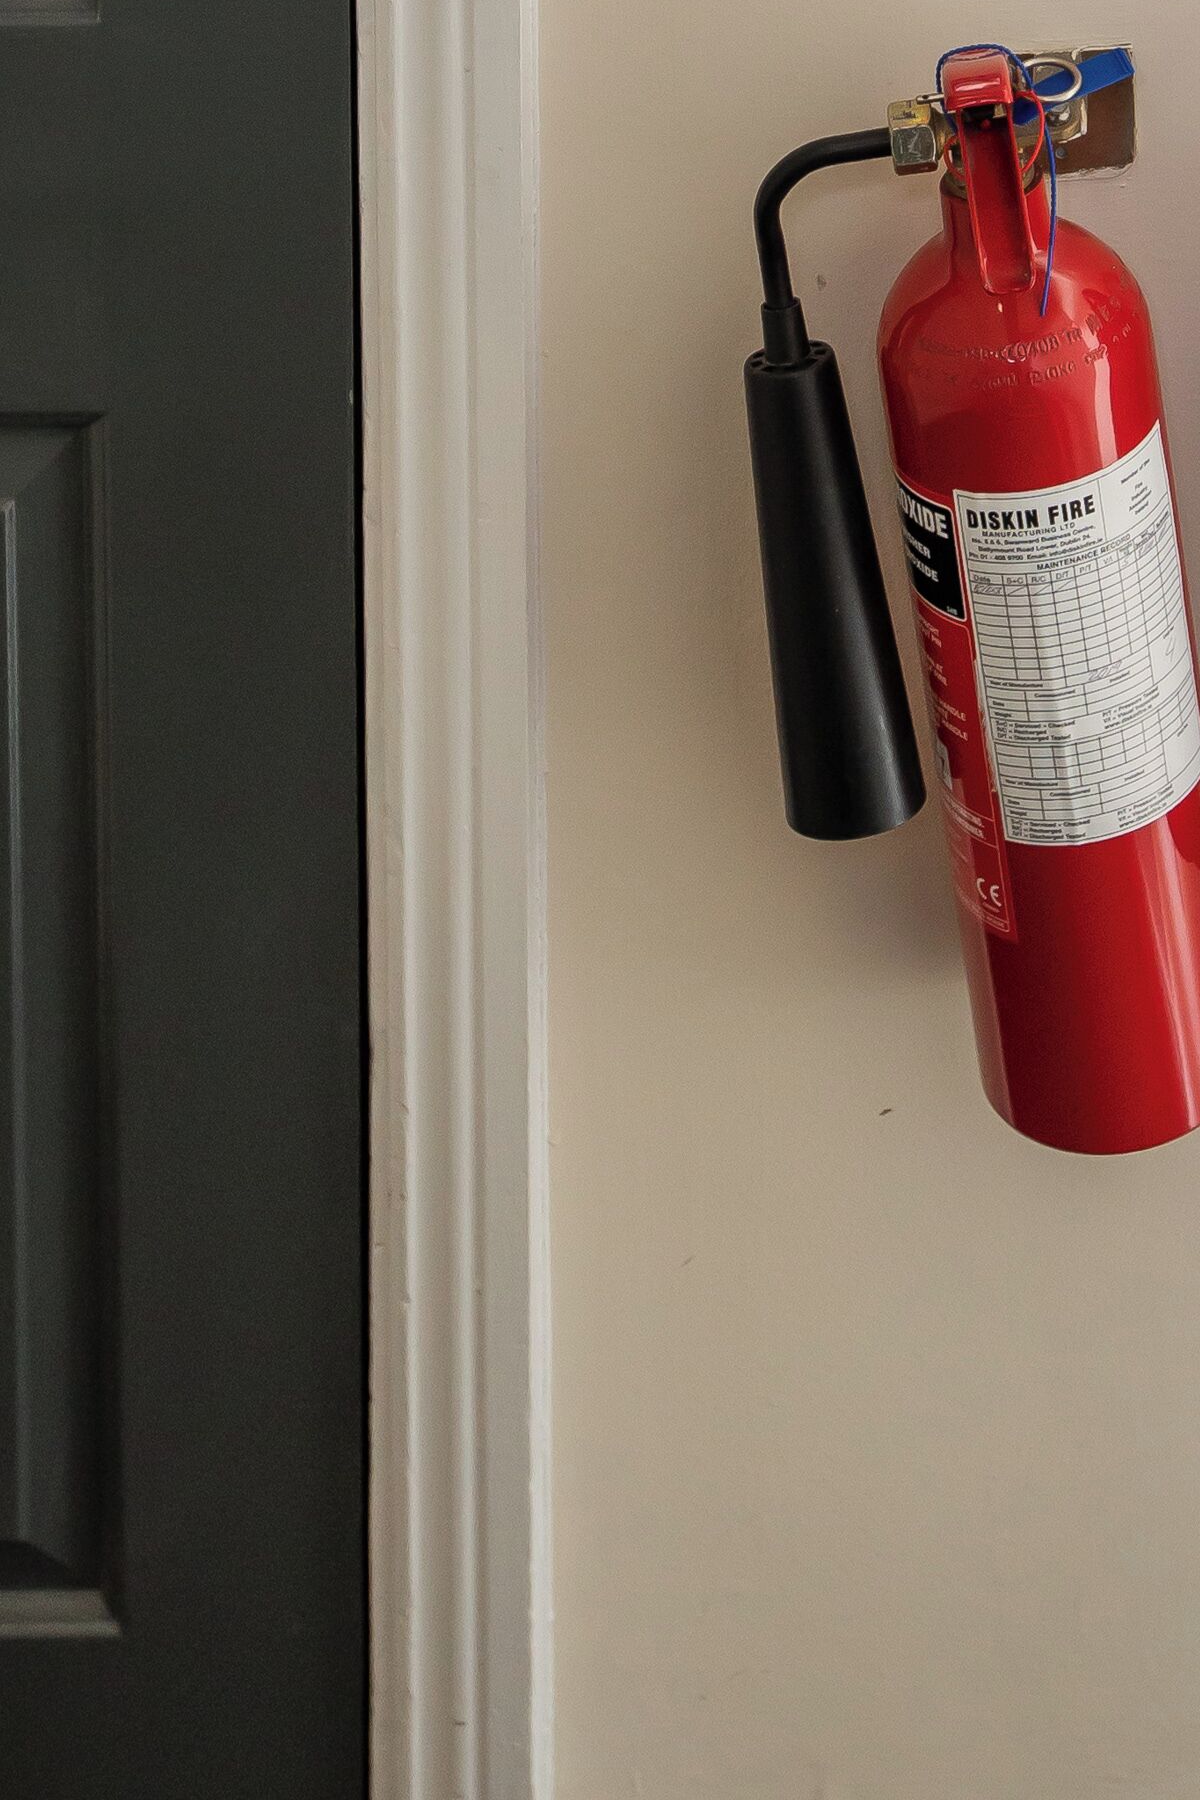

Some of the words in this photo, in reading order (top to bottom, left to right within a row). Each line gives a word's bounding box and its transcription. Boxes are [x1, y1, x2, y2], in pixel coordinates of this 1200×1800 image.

[899, 487, 949, 540] OXIDE
[966, 508, 1040, 530] DISKIN
[1047, 494, 1096, 526] FIRE
[982, 527, 1057, 538] MANUFACTURING
[1060, 522, 1075, 531] LTD
[1036, 549, 1099, 570] MAINTENANCE
